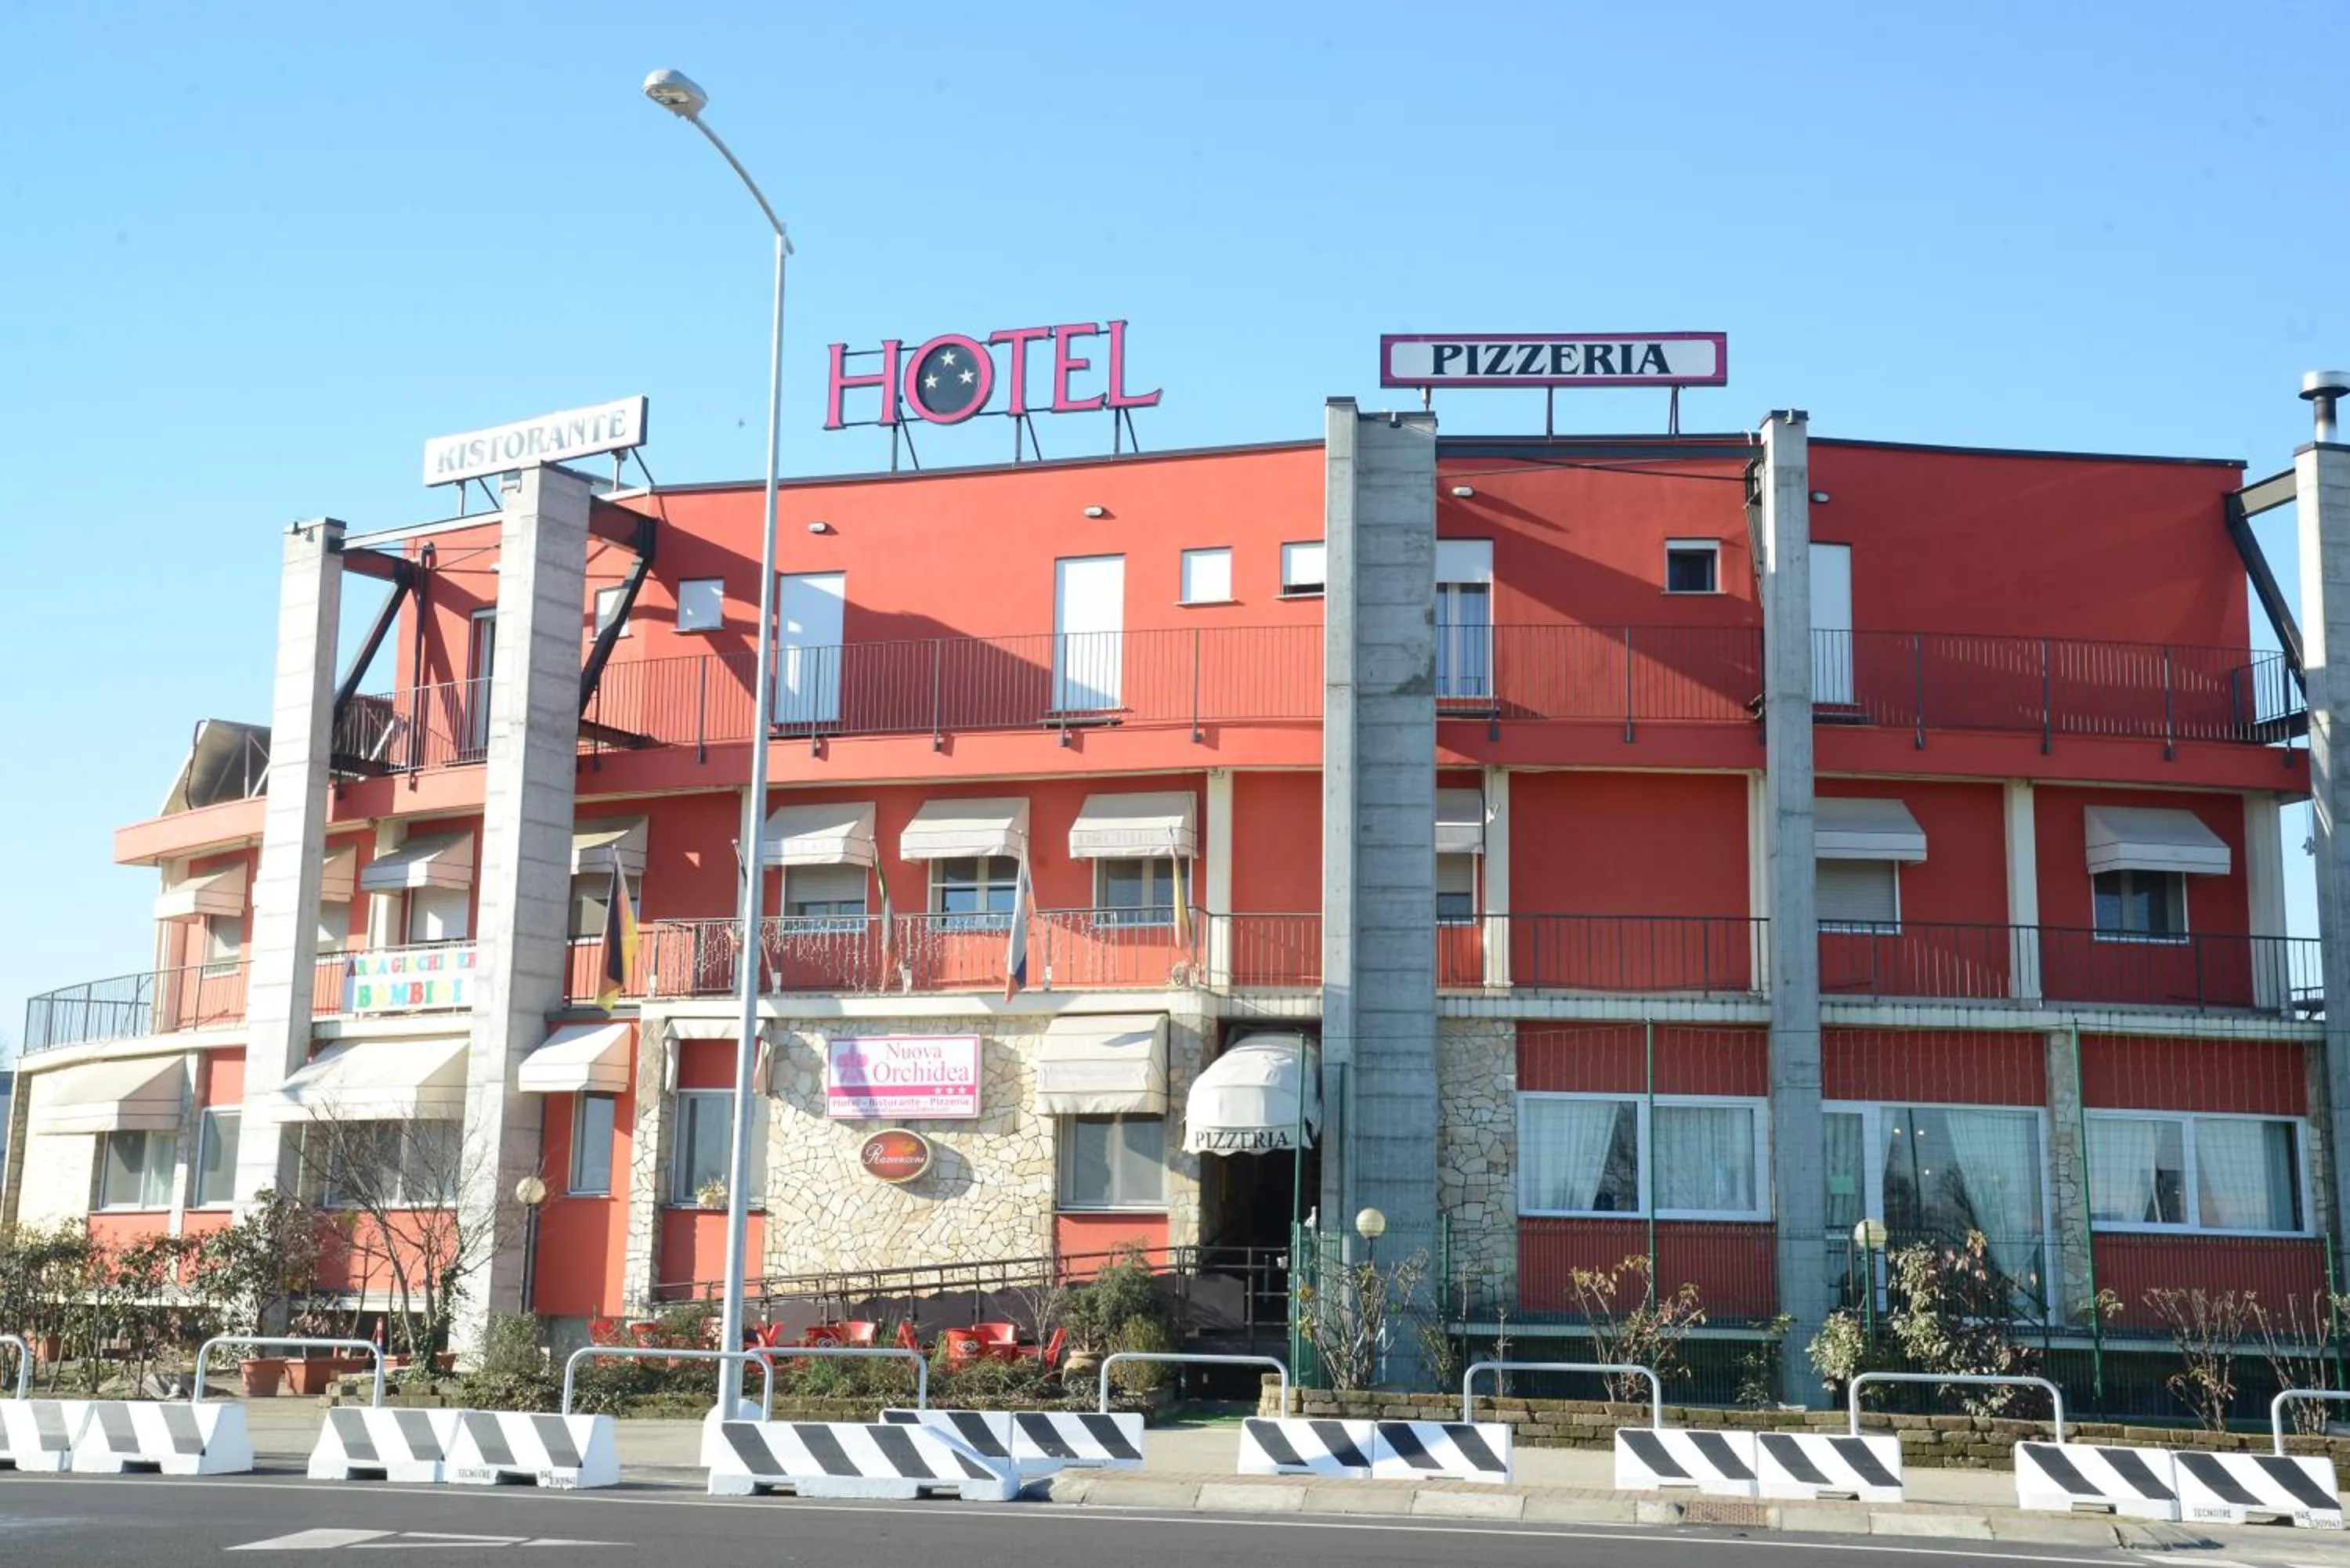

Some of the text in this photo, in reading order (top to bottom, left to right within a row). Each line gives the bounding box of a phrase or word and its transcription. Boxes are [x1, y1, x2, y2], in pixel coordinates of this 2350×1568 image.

[1430, 343, 1672, 376] PIZZERIA
[822, 319, 1164, 431] HOTEL
[436, 409, 627, 475] RISTORANTE
[345, 957, 389, 978] ARA
[356, 978, 465, 1008] BAMBII
[887, 1042, 943, 1059] Nuova
[873, 1061, 970, 1083] Orchidea
[1195, 1130, 1289, 1149] PIZZERIA
